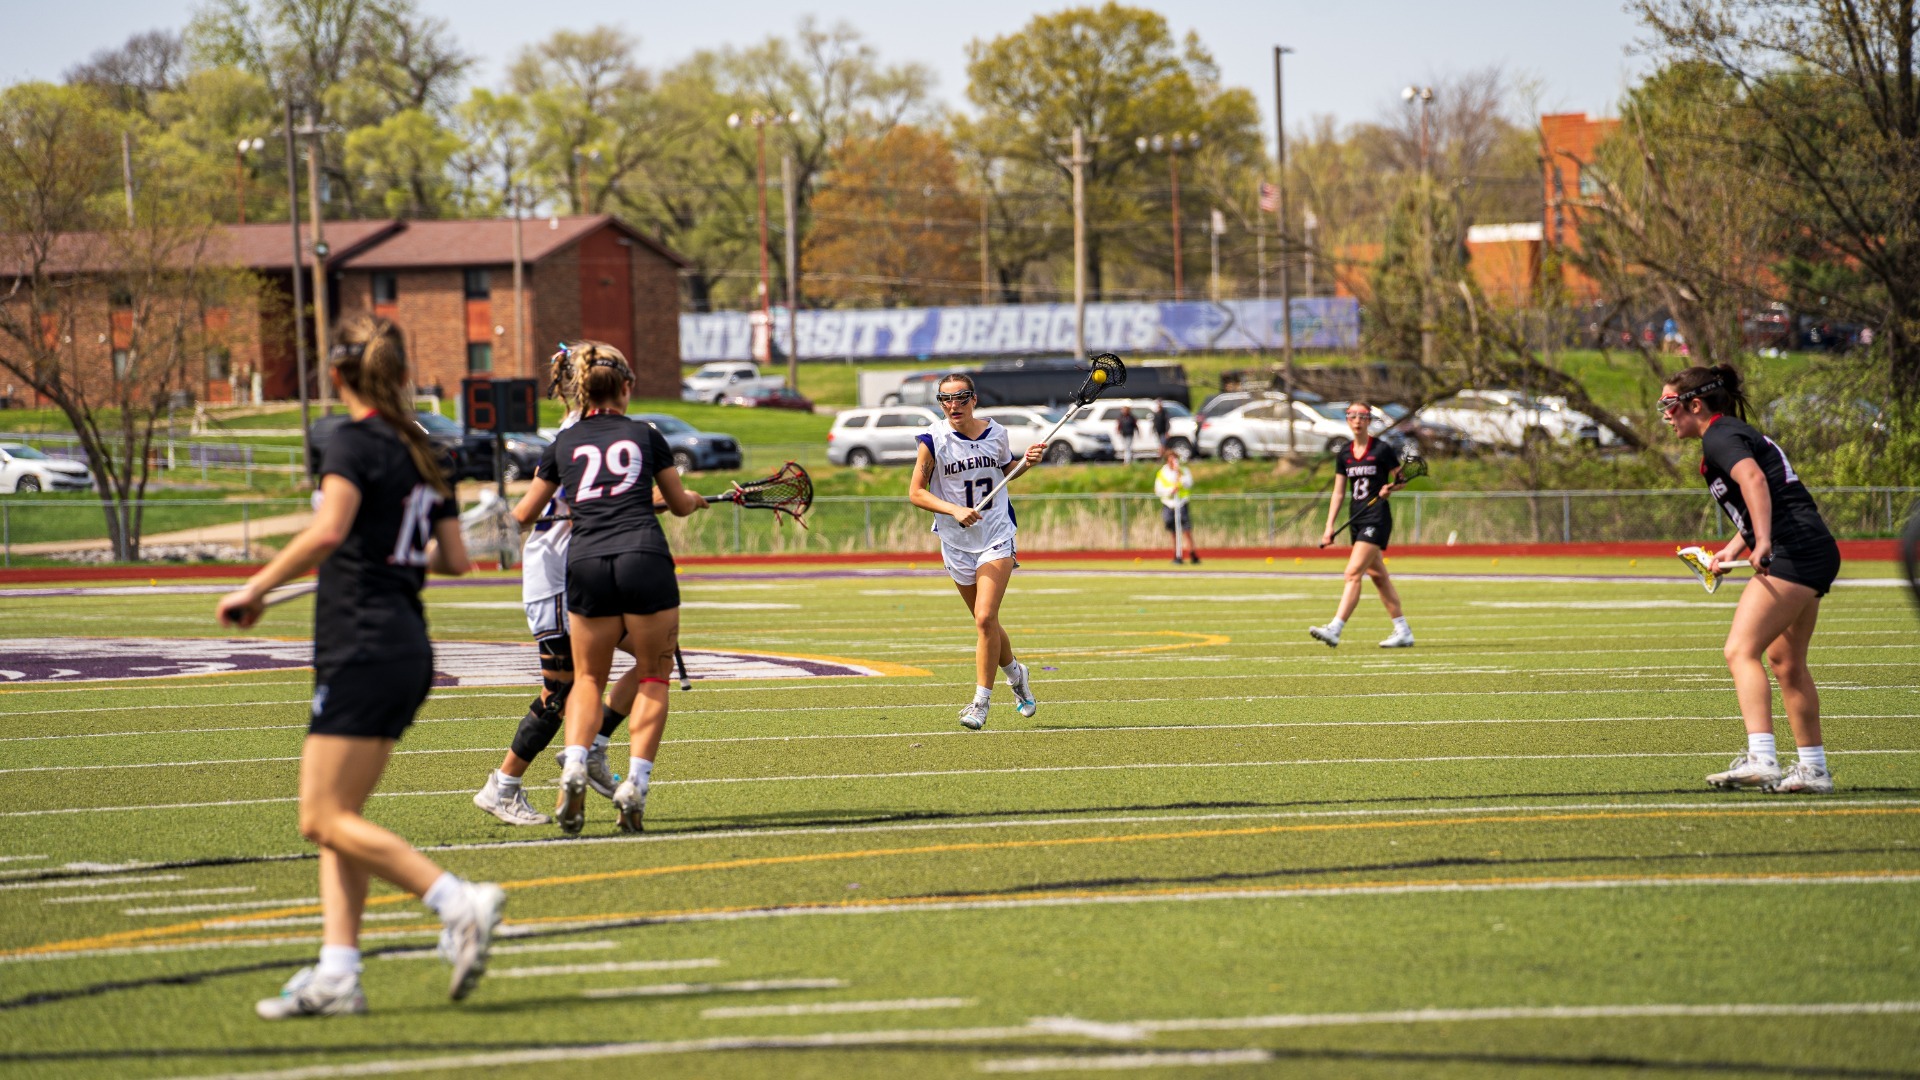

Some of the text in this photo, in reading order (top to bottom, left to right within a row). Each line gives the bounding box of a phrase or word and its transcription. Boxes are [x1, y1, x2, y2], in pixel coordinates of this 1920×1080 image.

[935, 303, 1161, 353] BEARCATS
[572, 440, 643, 503] 29
[1353, 477, 1370, 500] 13
[964, 477, 993, 511] 13
